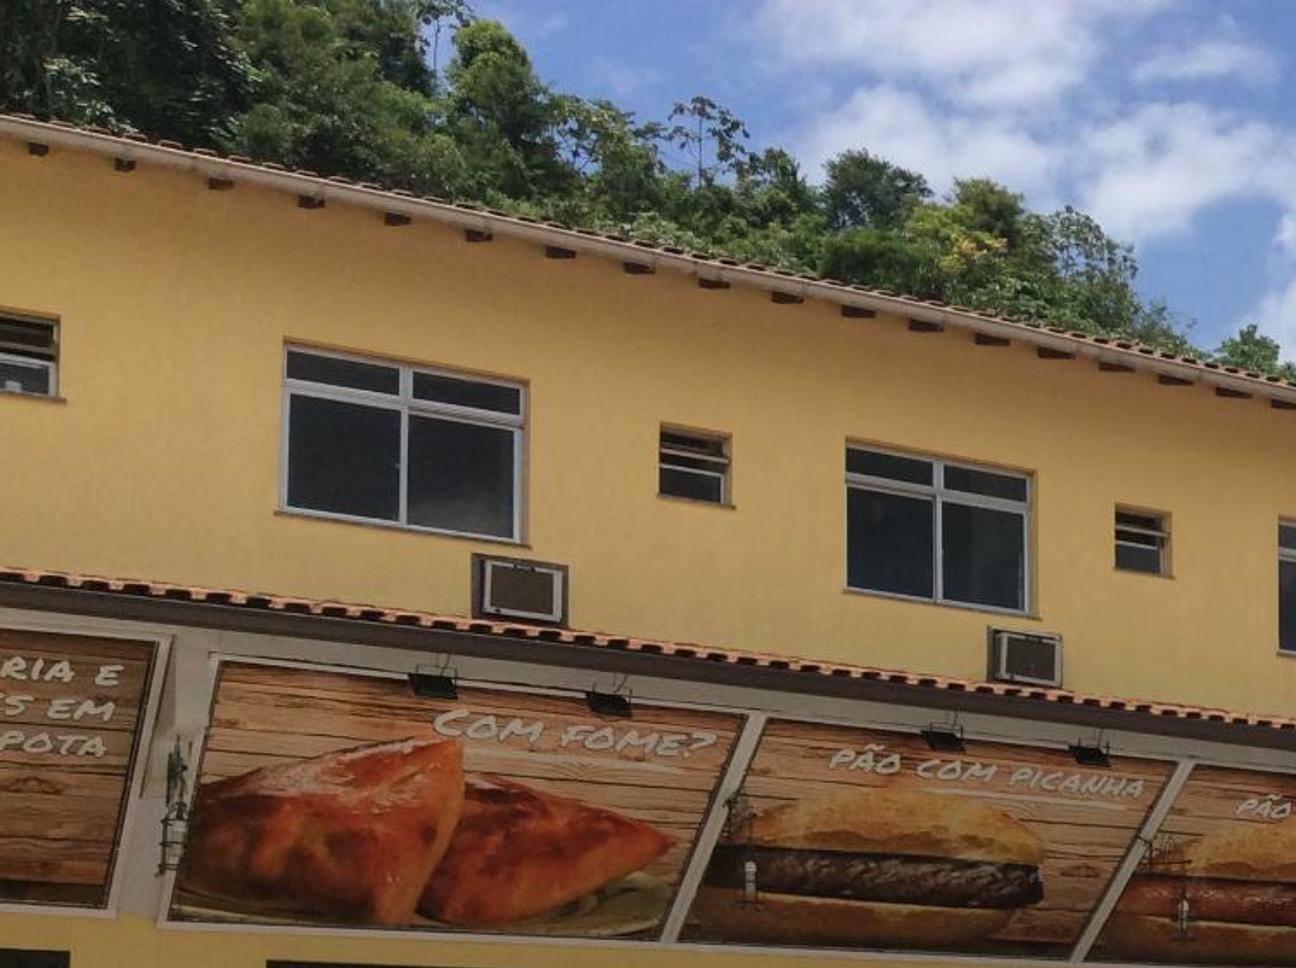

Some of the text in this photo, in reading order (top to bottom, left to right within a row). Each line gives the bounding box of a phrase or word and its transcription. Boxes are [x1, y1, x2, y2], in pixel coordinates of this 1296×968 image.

[0, 656, 125, 687] RIA E
[0, 693, 116, 722] S EM
[433, 709, 718, 758] COM FOME?
[829, 743, 1146, 798] PÃO COM PICANHA
[1236, 794, 1293, 819] PÃO
